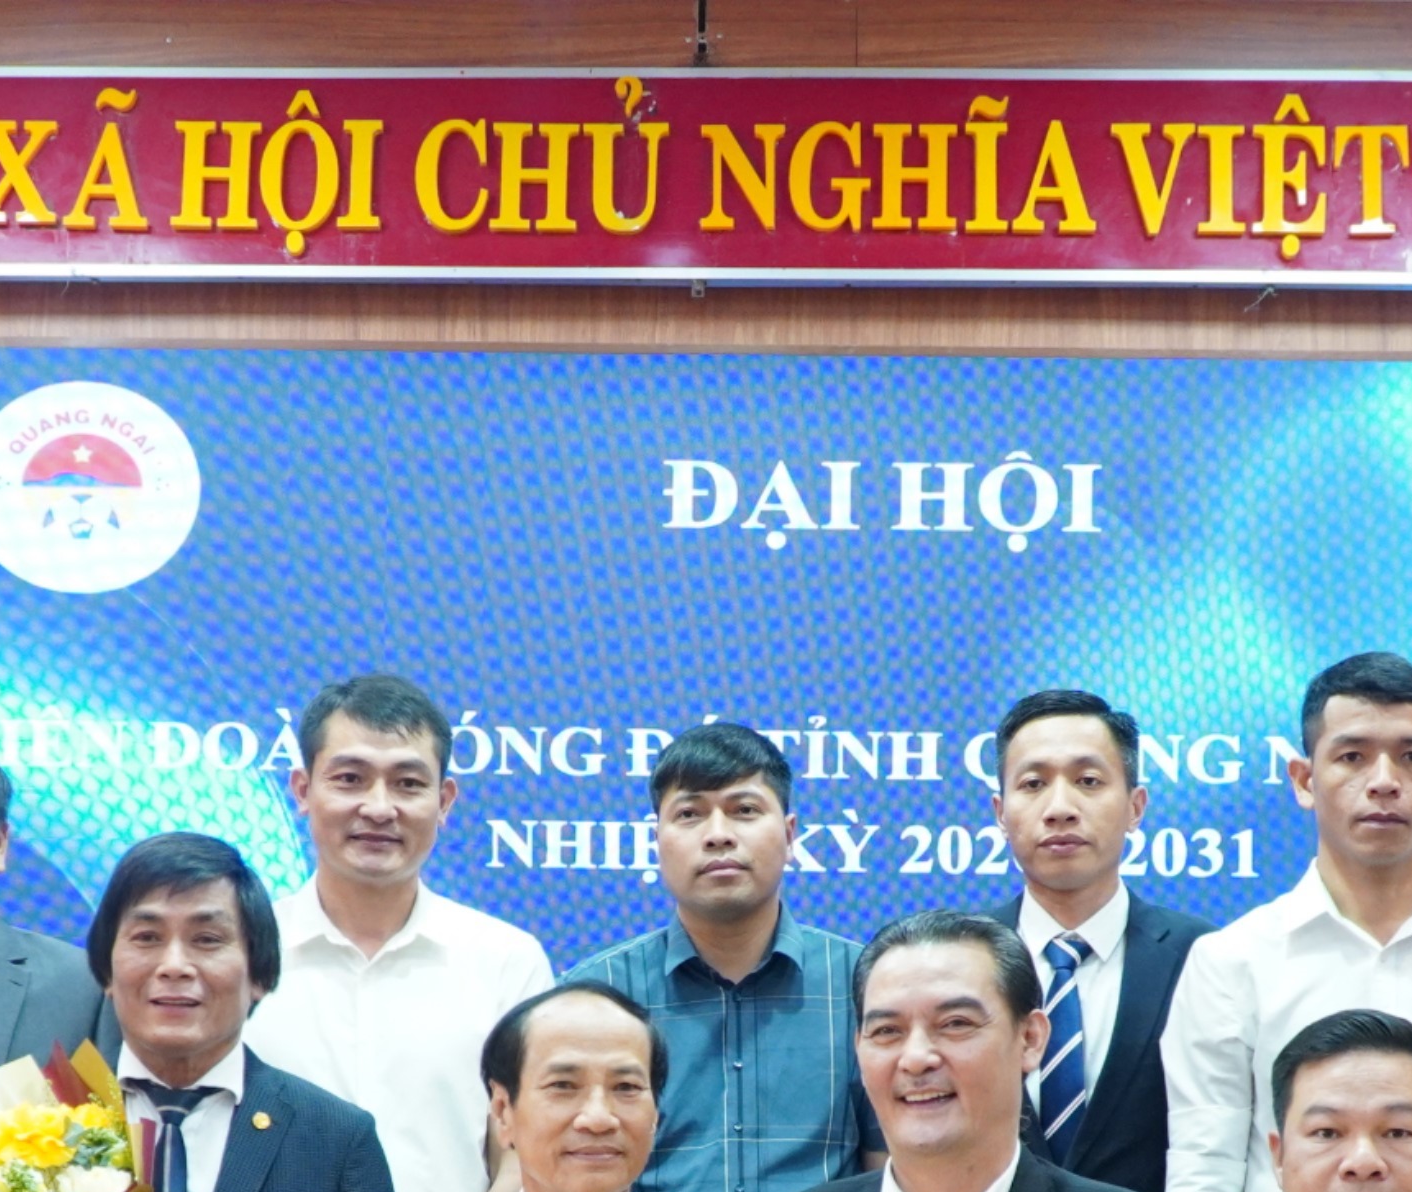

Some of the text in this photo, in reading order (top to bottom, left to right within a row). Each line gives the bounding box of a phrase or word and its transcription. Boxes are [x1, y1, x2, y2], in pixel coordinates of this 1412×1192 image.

[169, 89, 384, 256] HỘI
[414, 76, 669, 233] CHỦ
[698, 94, 1097, 235] NGHĨA
[1111, 93, 1409, 259] VIỆT
[662, 450, 1103, 553] ĐẠI HỘI
[149, 707, 305, 771] ĐOÀ
[447, 710, 606, 777] ÓNG
[486, 809, 1259, 884] NHIỆ KỲ 202 2031
